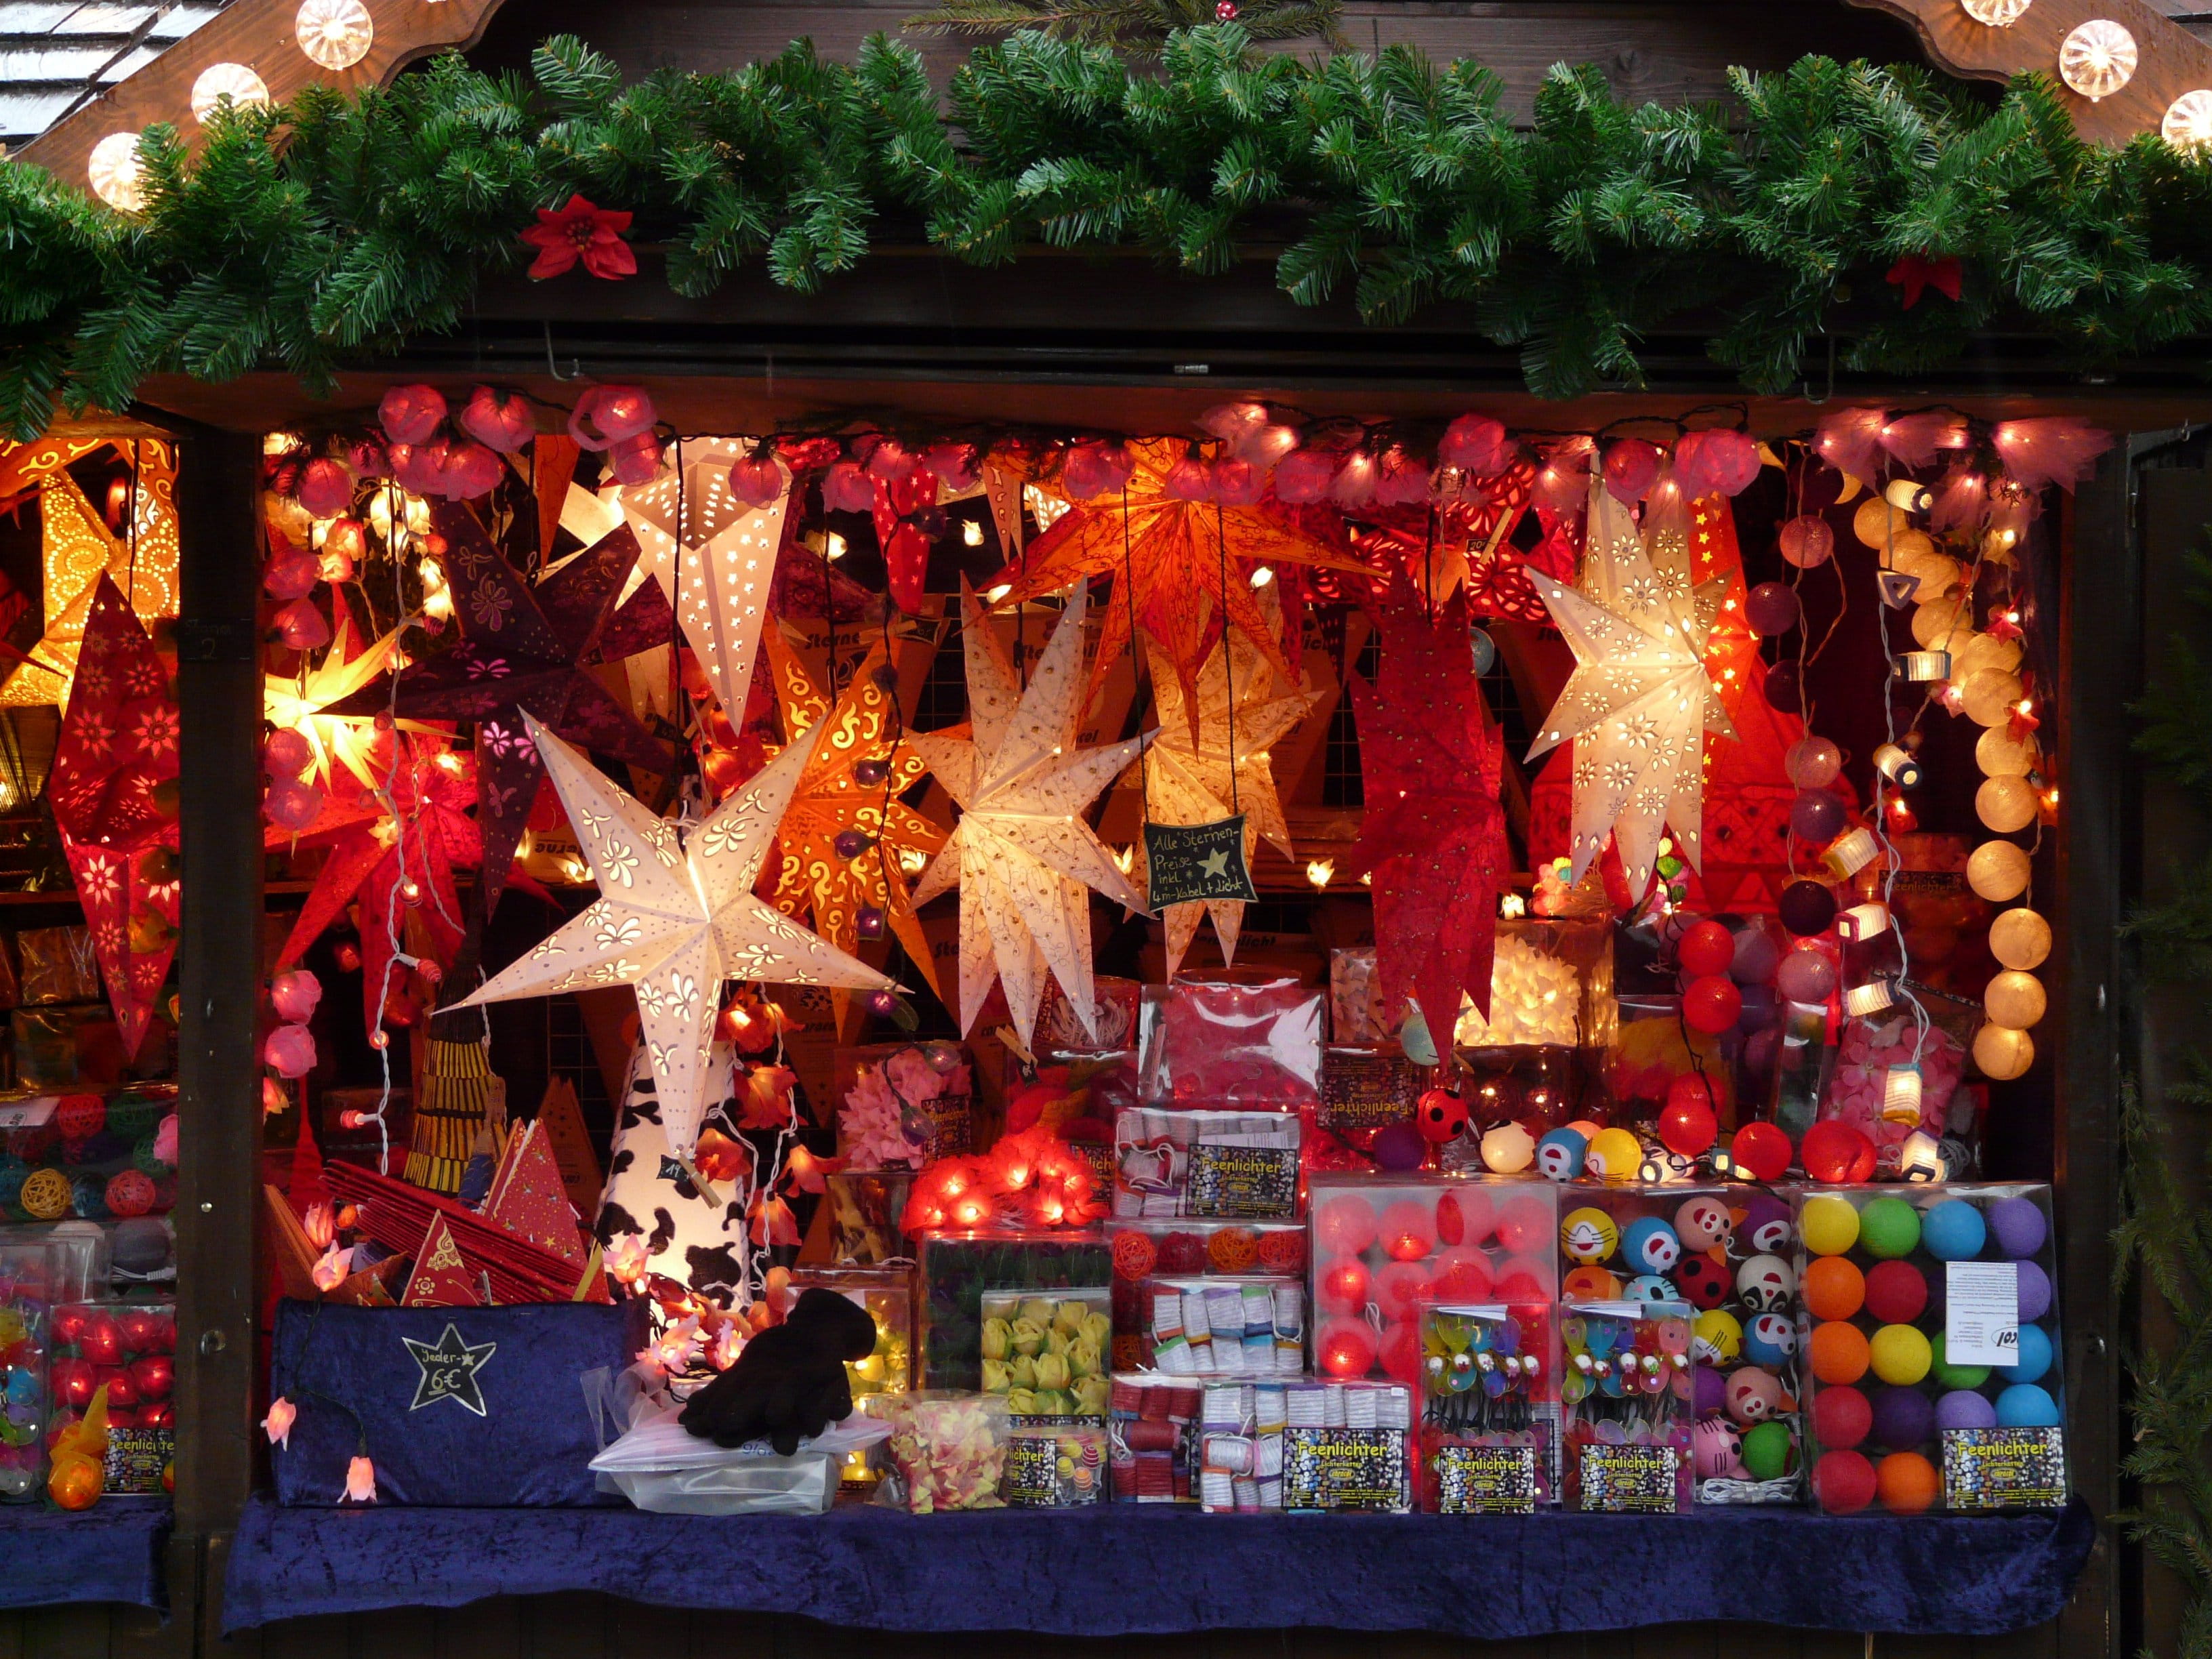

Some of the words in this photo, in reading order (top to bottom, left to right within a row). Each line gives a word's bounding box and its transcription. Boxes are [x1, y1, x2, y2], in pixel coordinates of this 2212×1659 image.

[1153, 834, 1179, 851] Alle
[1182, 827, 1240, 847] Sternen-
[1153, 855, 1192, 872] Preise
[1215, 876, 1243, 894] Licht
[1201, 1157, 1282, 1174] Feenlichter
[1297, 1441, 1388, 1456] Feenlichter
[1957, 1440, 2048, 1456] Feenlichter
[1448, 1458, 1523, 1471] Feenlichter
[1588, 1455, 1663, 1469] Feenlichter
